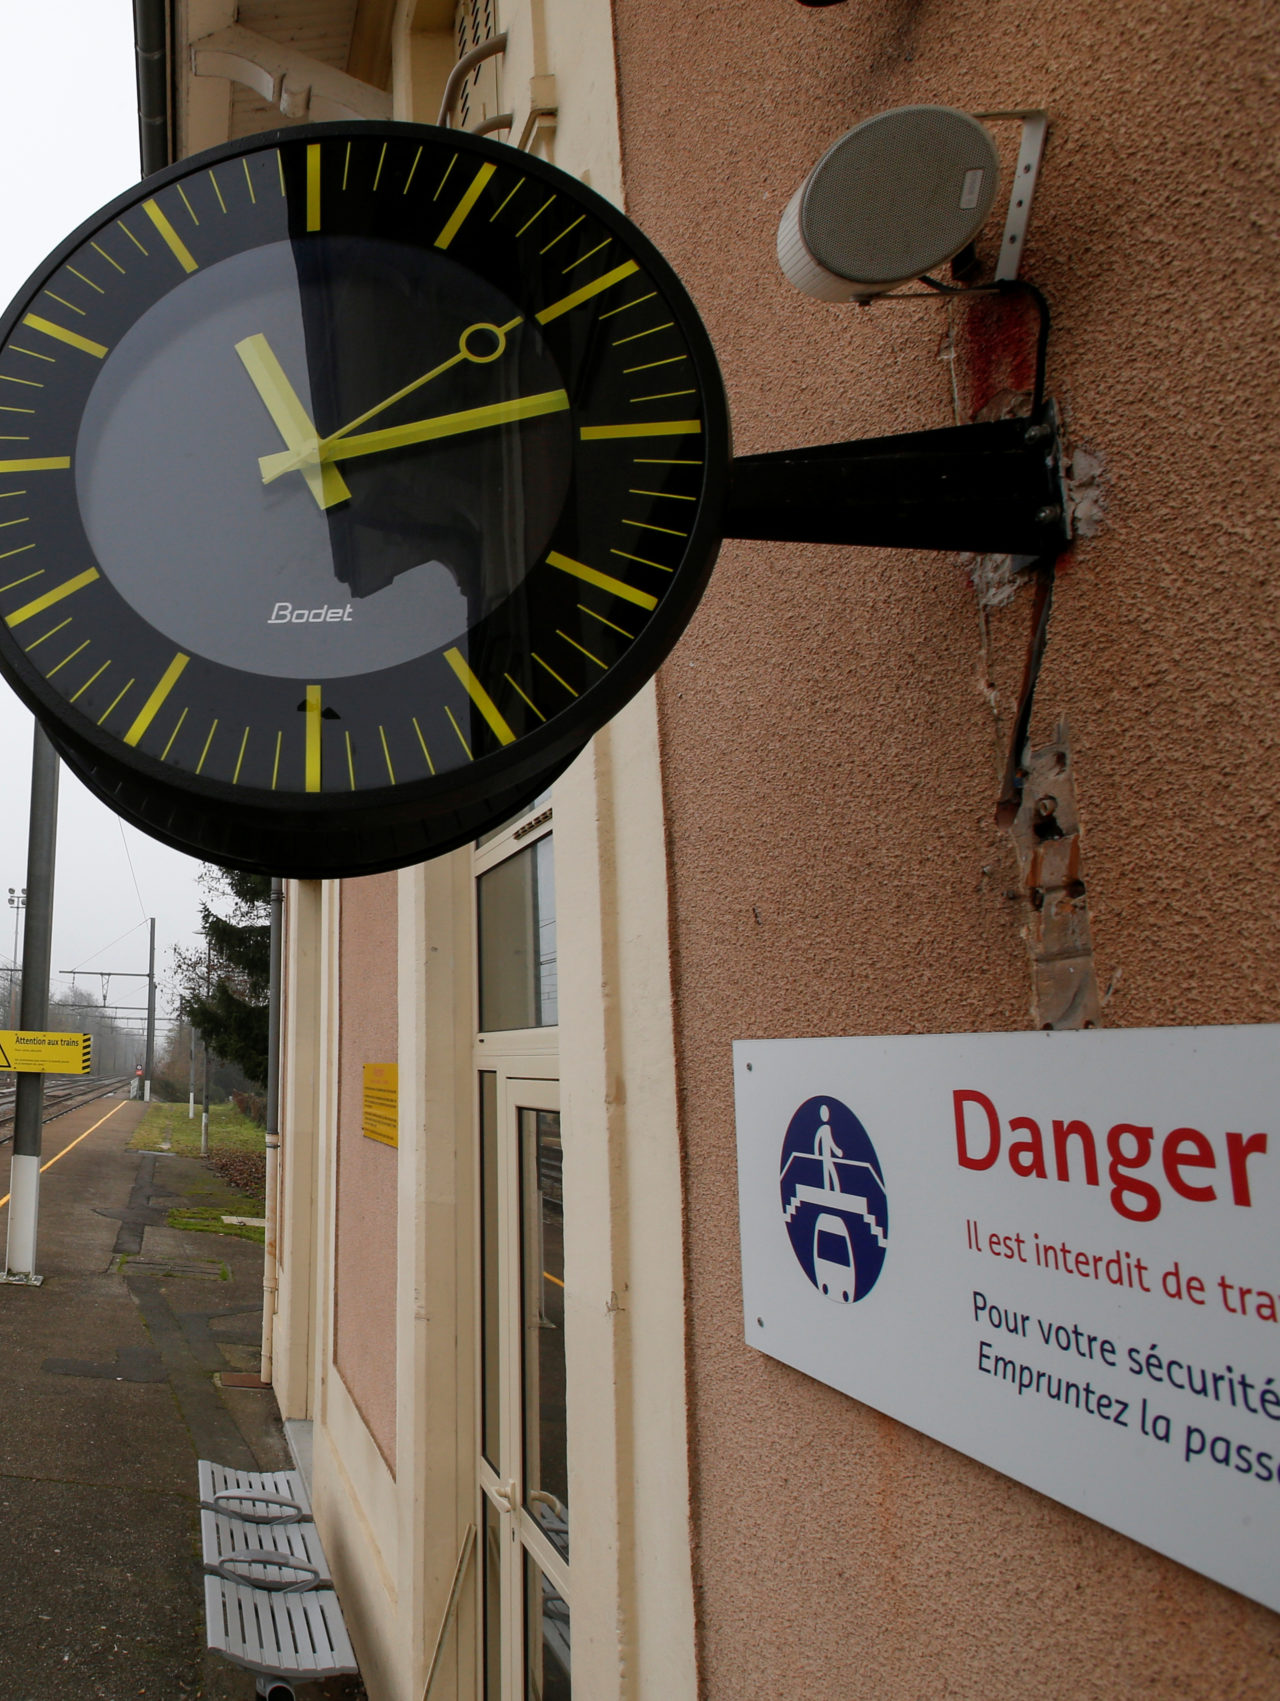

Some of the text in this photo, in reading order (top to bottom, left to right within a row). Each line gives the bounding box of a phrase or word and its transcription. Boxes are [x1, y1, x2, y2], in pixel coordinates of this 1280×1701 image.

[267, 602, 353, 624] Bodet
[16, 1036, 46, 1045] Attention
[60, 1038, 79, 1046] trains
[953, 1089, 1267, 1222] Danger
[967, 1219, 1280, 1323] Il est interdit de tra
[973, 1291, 1030, 1338] Pour
[1037, 1319, 1117, 1367] votre
[979, 1341, 1280, 1484] Empruntez la pass
